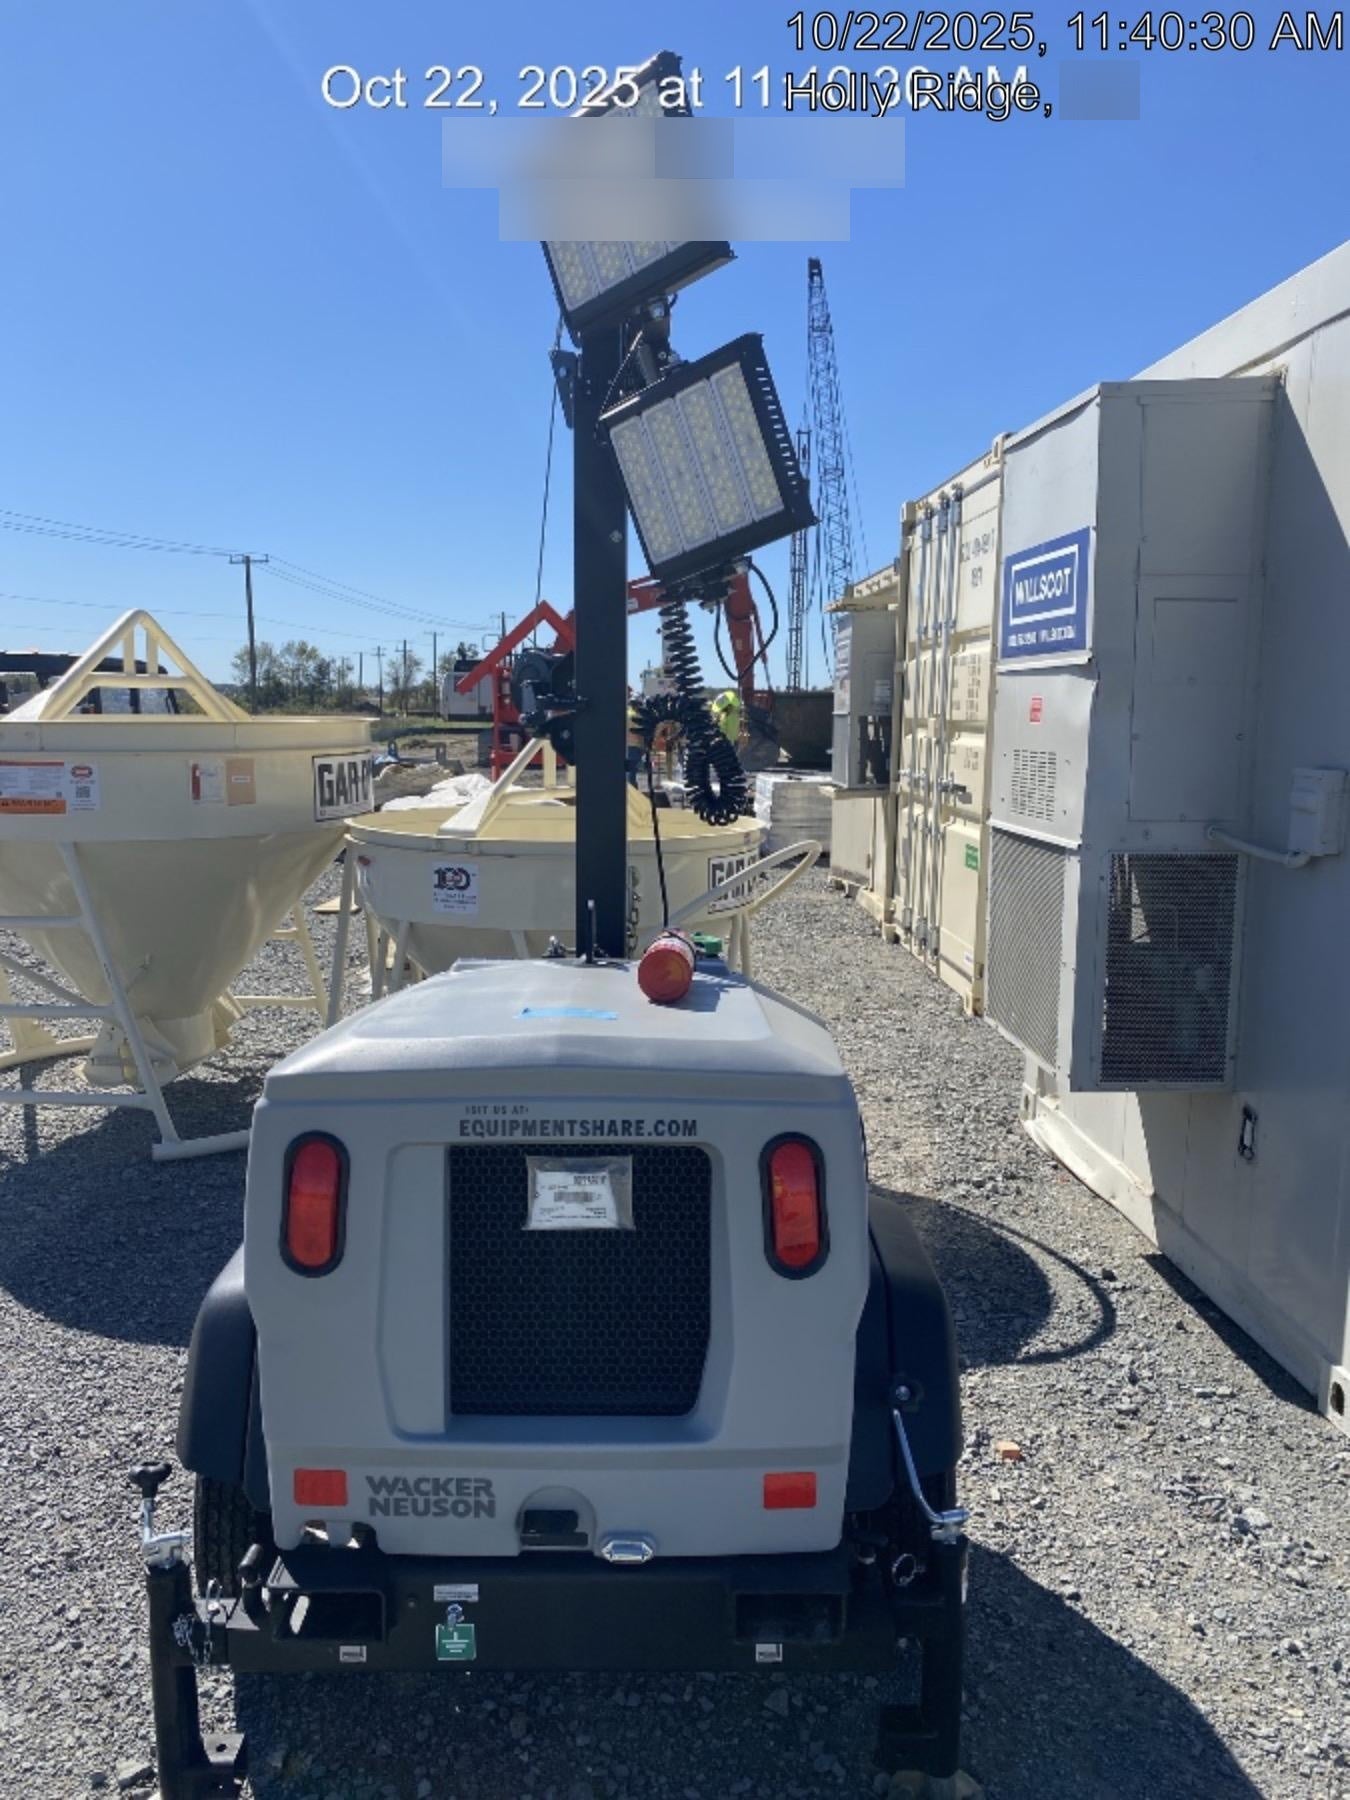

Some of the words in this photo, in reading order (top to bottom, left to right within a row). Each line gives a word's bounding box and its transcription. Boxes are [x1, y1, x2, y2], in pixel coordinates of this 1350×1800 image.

[458, 1118, 698, 1139] EQUIPMENTSHARE.COM
[365, 1475, 496, 1498] WACKER
[367, 1497, 497, 1519] NEUSON
